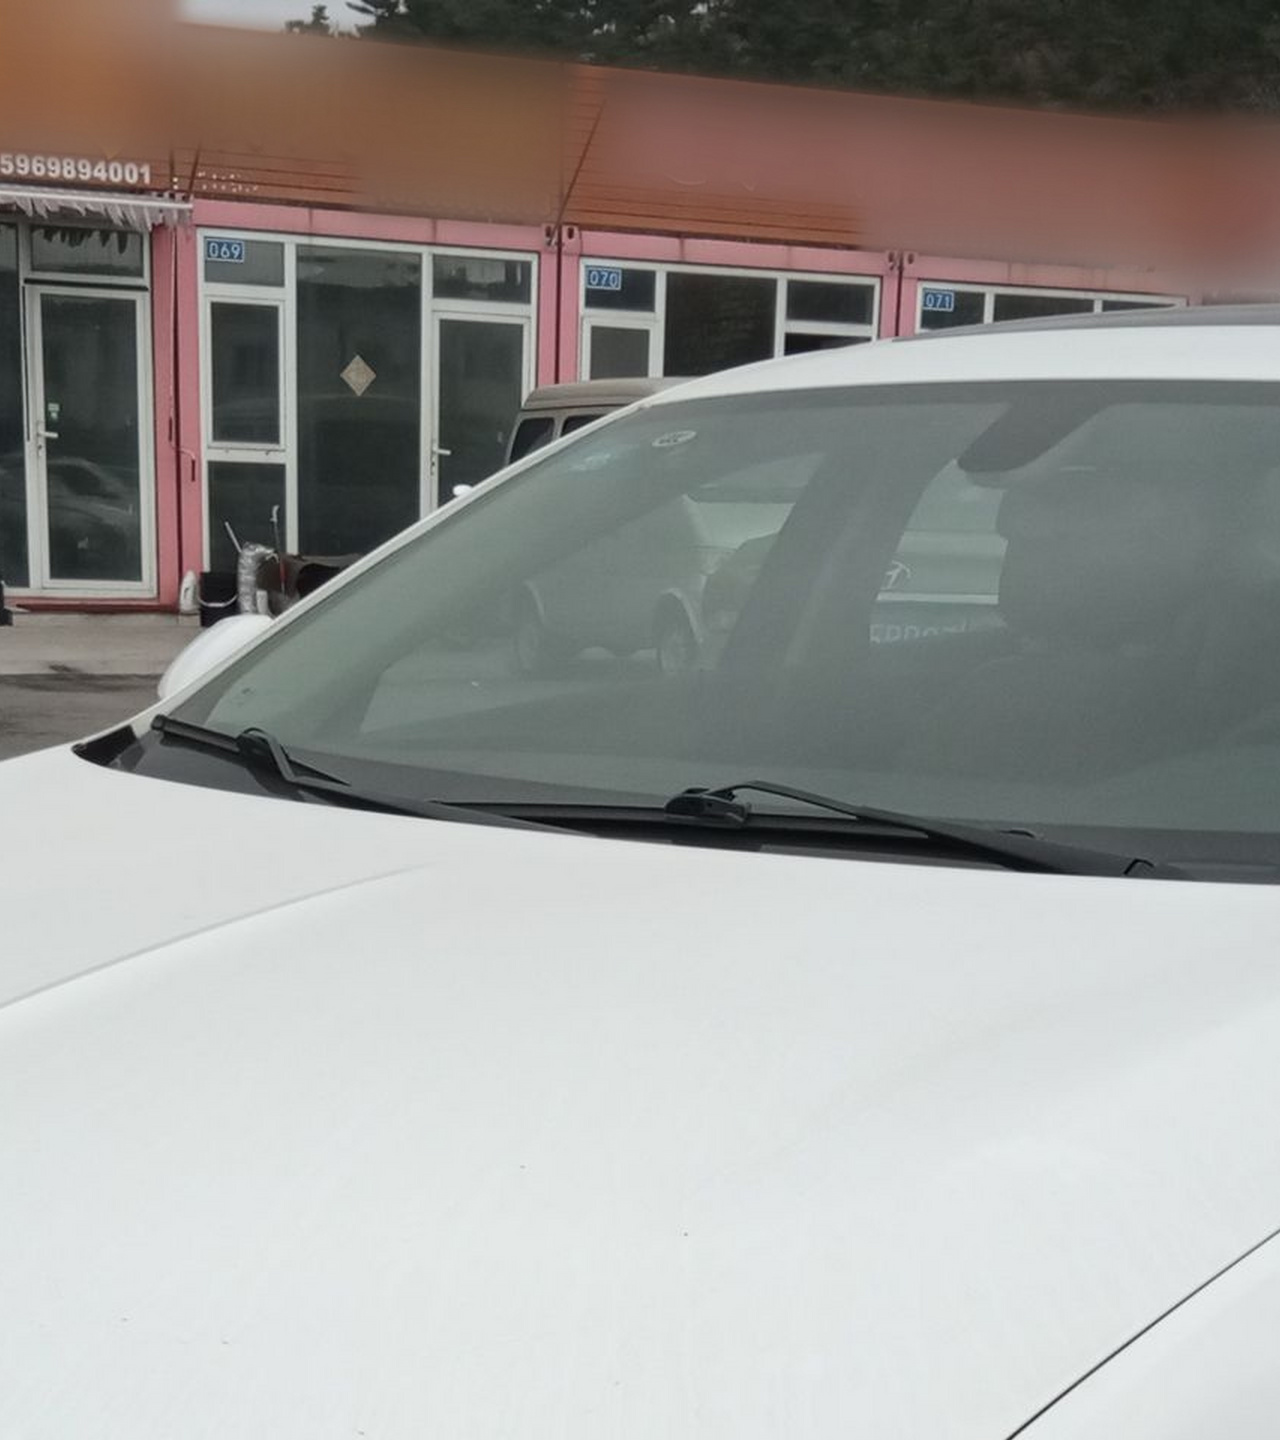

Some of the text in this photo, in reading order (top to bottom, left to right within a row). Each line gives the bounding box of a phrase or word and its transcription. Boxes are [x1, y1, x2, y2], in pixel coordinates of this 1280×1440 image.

[209, 242, 240, 259] 069
[590, 270, 618, 288] 070
[926, 293, 950, 309] 071
